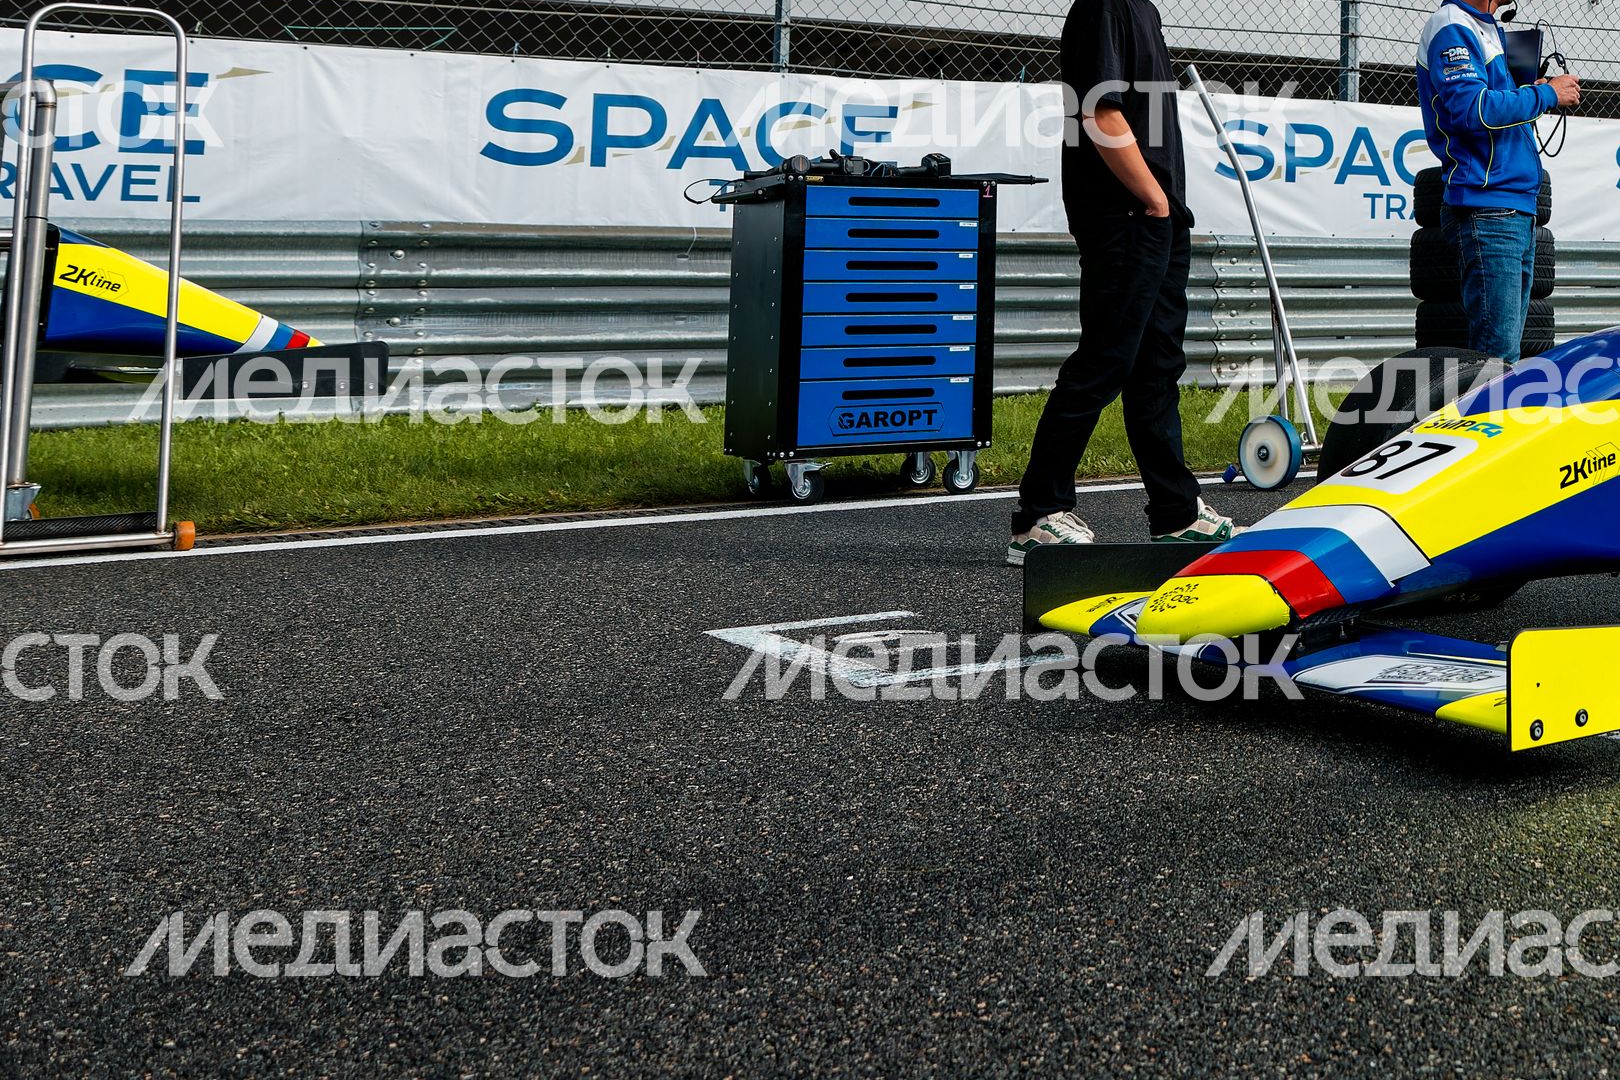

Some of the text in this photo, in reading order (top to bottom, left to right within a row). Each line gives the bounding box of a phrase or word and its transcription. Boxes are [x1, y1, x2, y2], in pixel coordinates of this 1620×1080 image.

[479, 88, 899, 172] SPACE
[58, 264, 122, 294] 2Kline
[837, 408, 938, 430] GAROPT
[1340, 440, 1456, 480] 87
[1559, 451, 1617, 490] 2Kline
